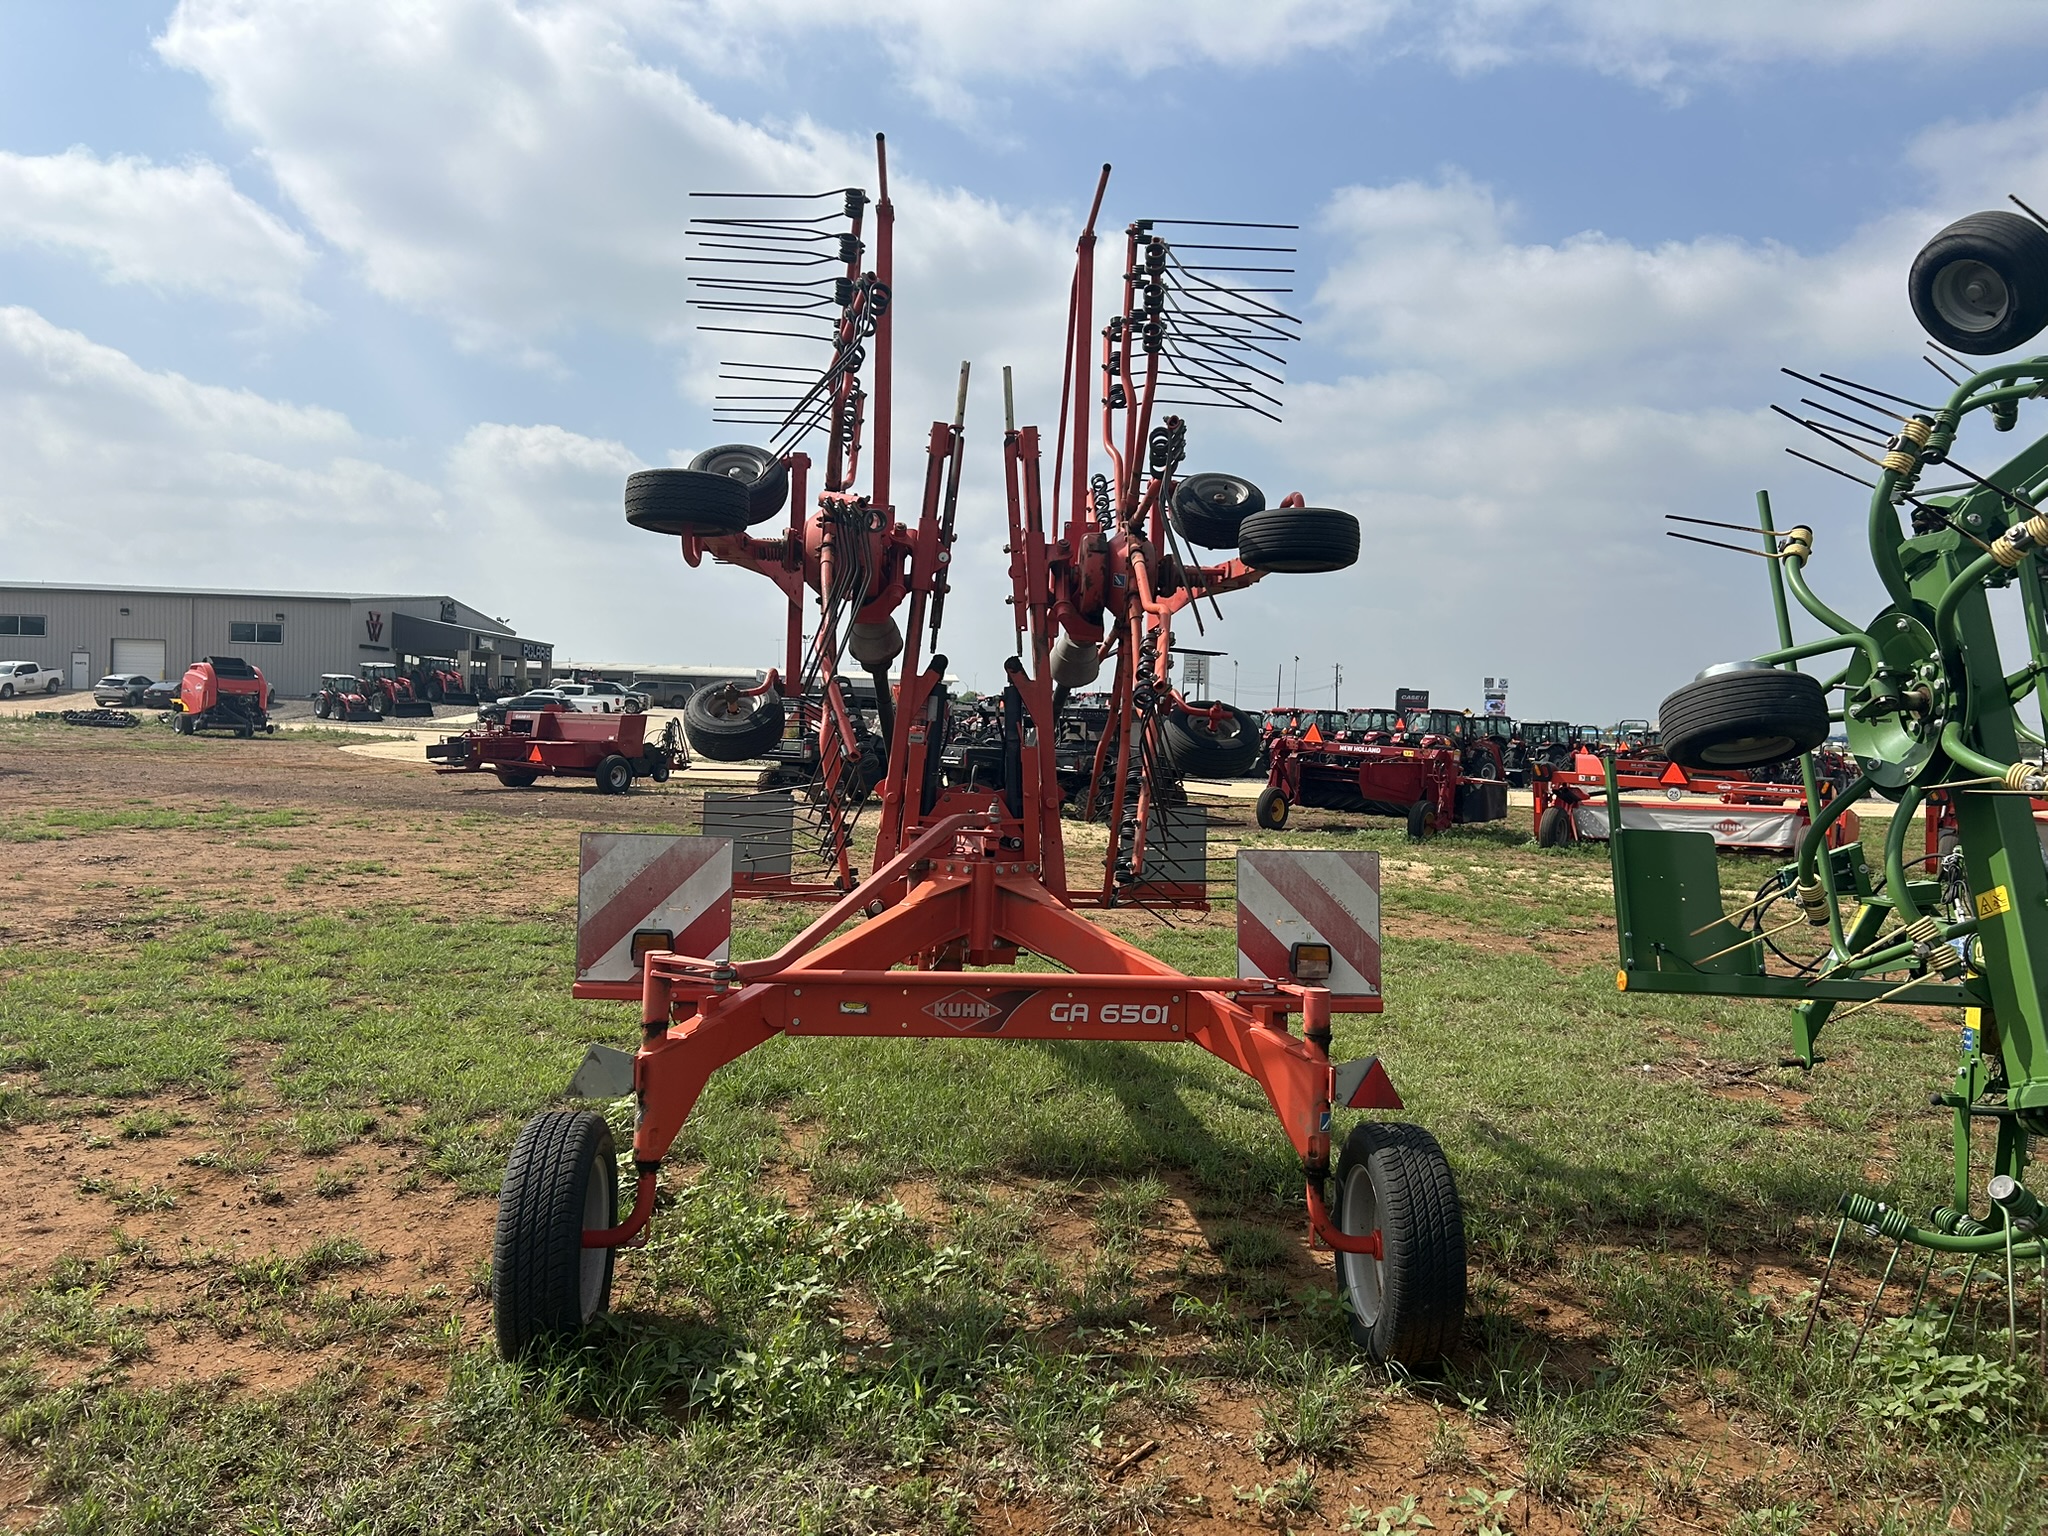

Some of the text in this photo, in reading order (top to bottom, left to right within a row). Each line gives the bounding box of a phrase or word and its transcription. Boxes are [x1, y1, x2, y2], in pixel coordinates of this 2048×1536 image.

[523, 643, 551, 660] POLARIS
[1353, 745, 1381, 754] HOLLAND
[1713, 823, 1744, 832] KUHN
[933, 1003, 990, 1018] KUHN
[1050, 1003, 1169, 1024] GA 6501
